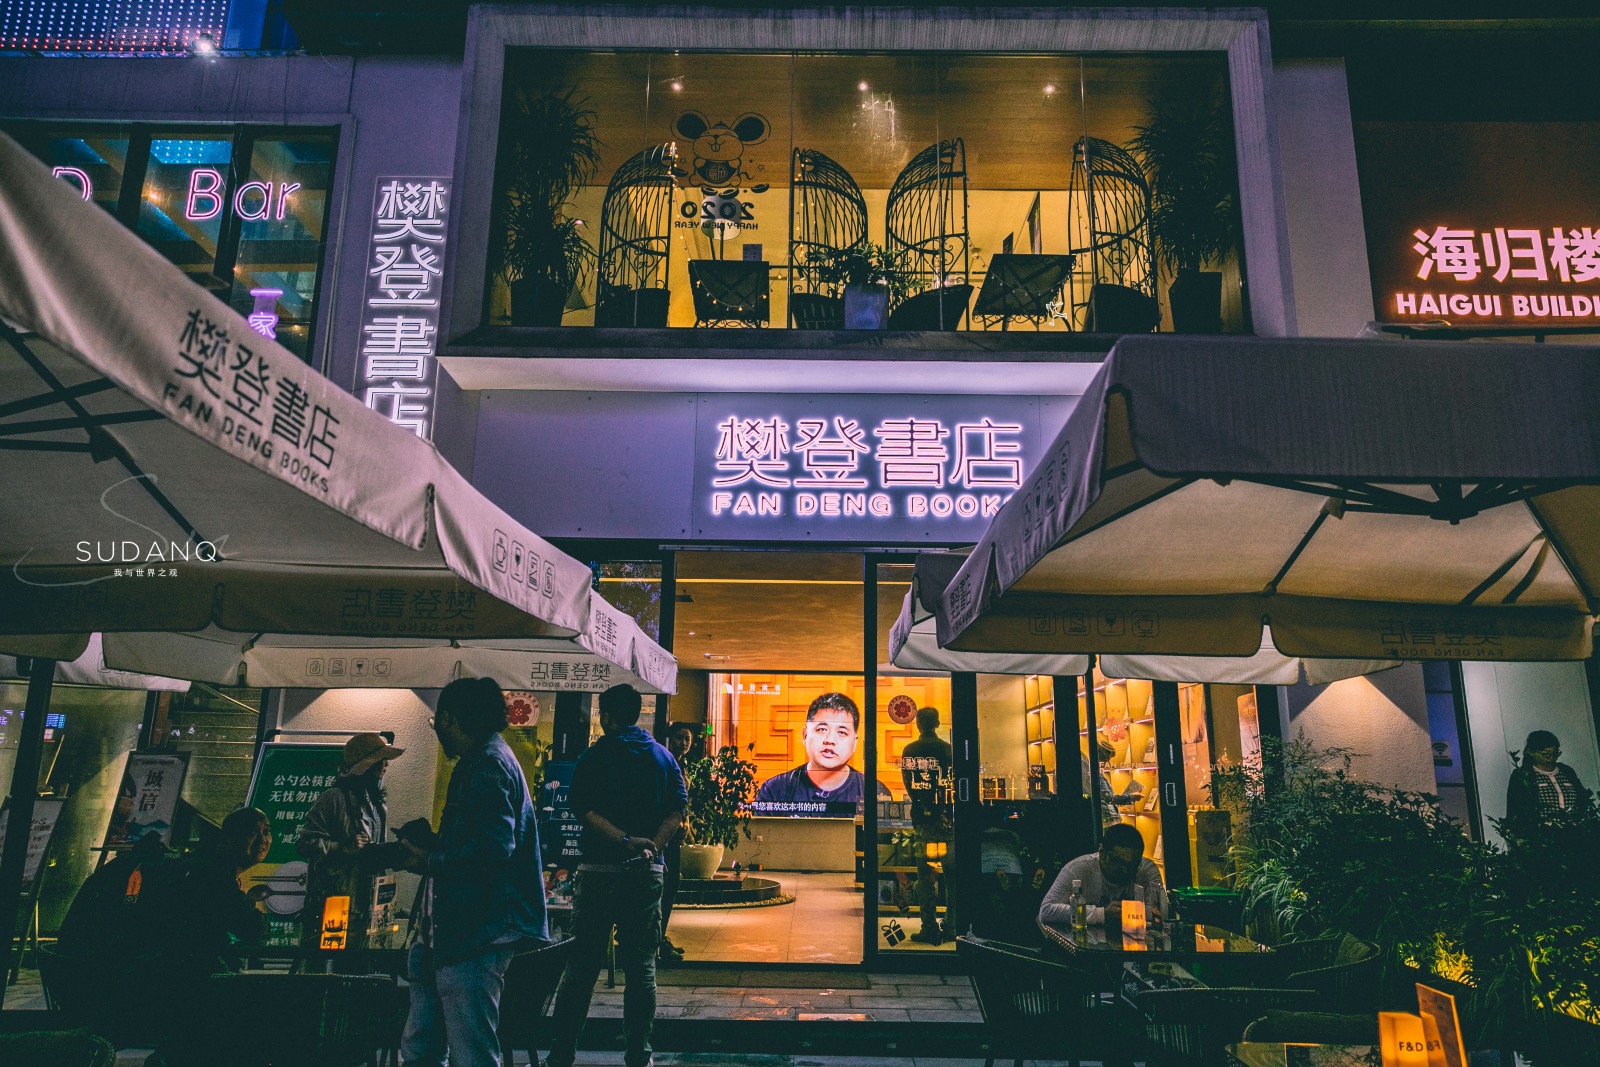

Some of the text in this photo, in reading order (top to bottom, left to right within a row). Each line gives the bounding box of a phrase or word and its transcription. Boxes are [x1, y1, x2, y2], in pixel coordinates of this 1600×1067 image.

[186, 168, 300, 221] Bar
[1413, 226, 1600, 283] 海归楼
[363, 180, 446, 438] 樊登書店
[1396, 293, 1502, 316] HAIGUI
[174, 309, 340, 470] 樊登書店
[163, 382, 329, 493] FAN DENG BOOKS
[713, 416, 1024, 489] 樊登書店
[712, 492, 1012, 517] FAN DENG BOOK
[1398, 1041, 1424, 1052] F&D
